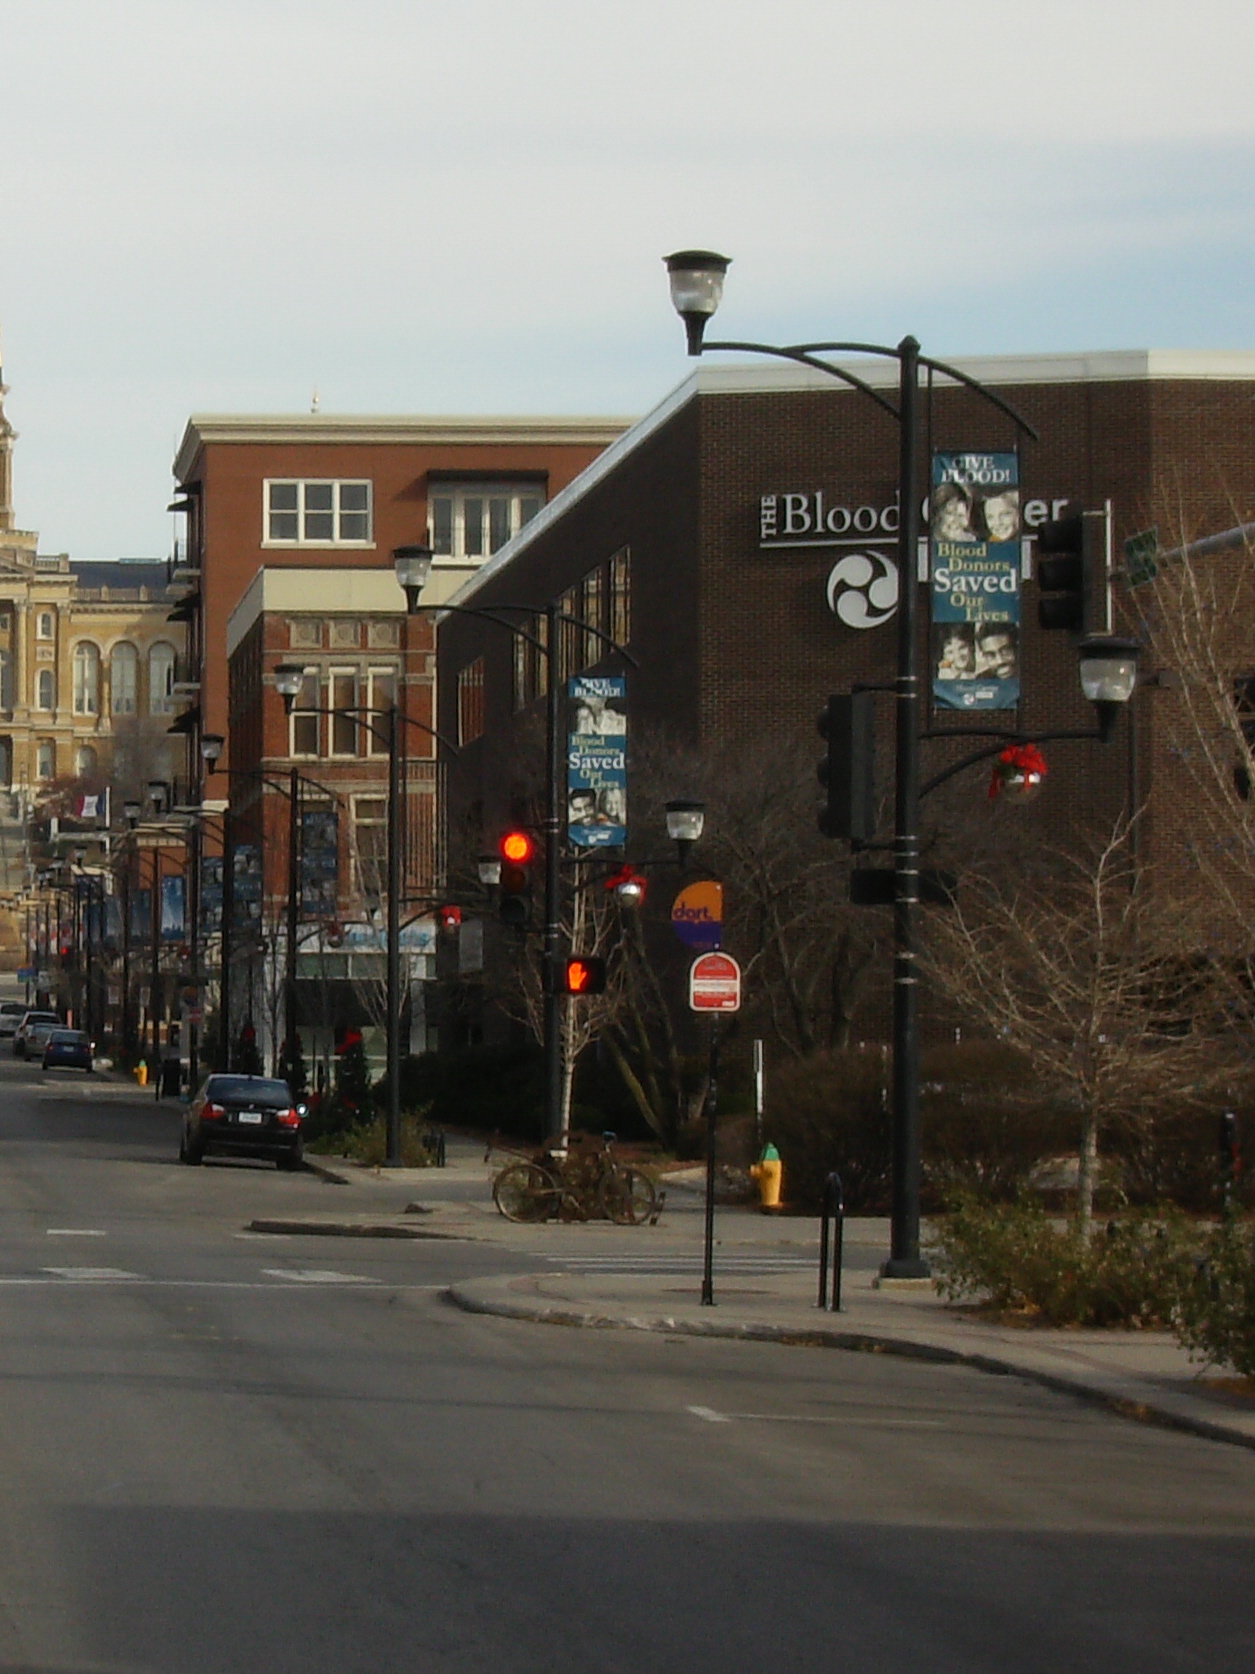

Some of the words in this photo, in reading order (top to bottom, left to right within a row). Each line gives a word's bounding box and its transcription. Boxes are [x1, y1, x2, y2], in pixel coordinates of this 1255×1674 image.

[941, 469, 1011, 483] BLOOD!
[761, 495, 777, 538] THE
[938, 543, 987, 557] Blood
[949, 558, 1011, 572] Donors
[934, 568, 1017, 593] Saved
[950, 592, 985, 607] Our
[966, 607, 1010, 621] Lives
[569, 752, 625, 769] Saved
